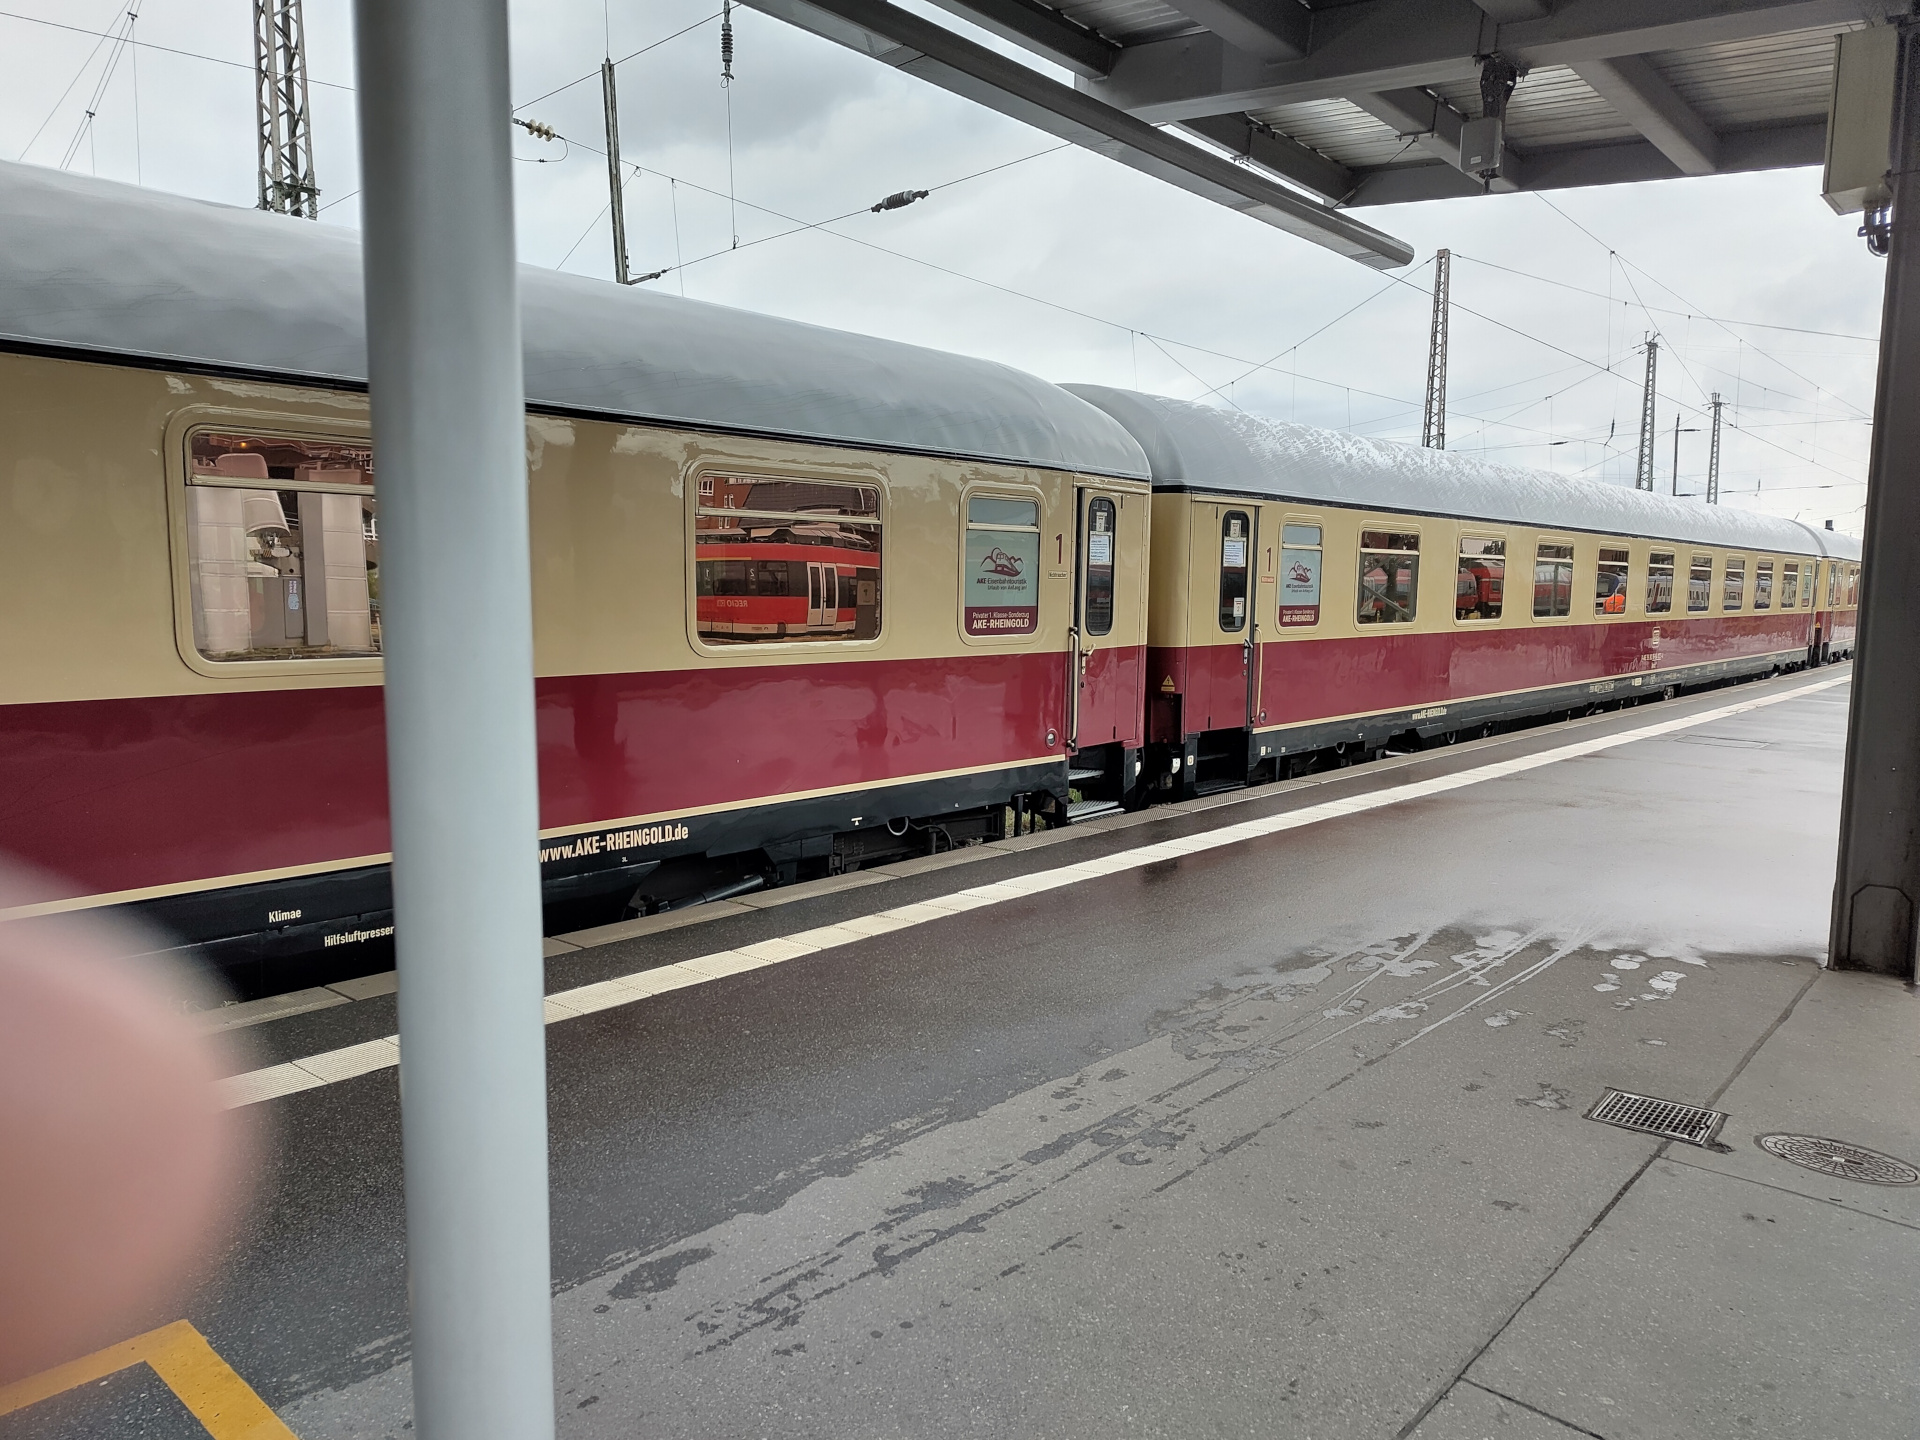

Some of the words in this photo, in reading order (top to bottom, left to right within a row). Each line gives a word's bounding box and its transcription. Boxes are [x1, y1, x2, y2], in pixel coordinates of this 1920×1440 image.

[1055, 533, 1063, 565] 1
[1266, 546, 1272, 573] 1
[972, 618, 1030, 629] AKE-RHEINGOLD
[538, 822, 689, 863] www.AKE-RHEINGOLD.de
[268, 909, 302, 923] Klimae
[324, 925, 395, 947] Hilfsluftpresser
